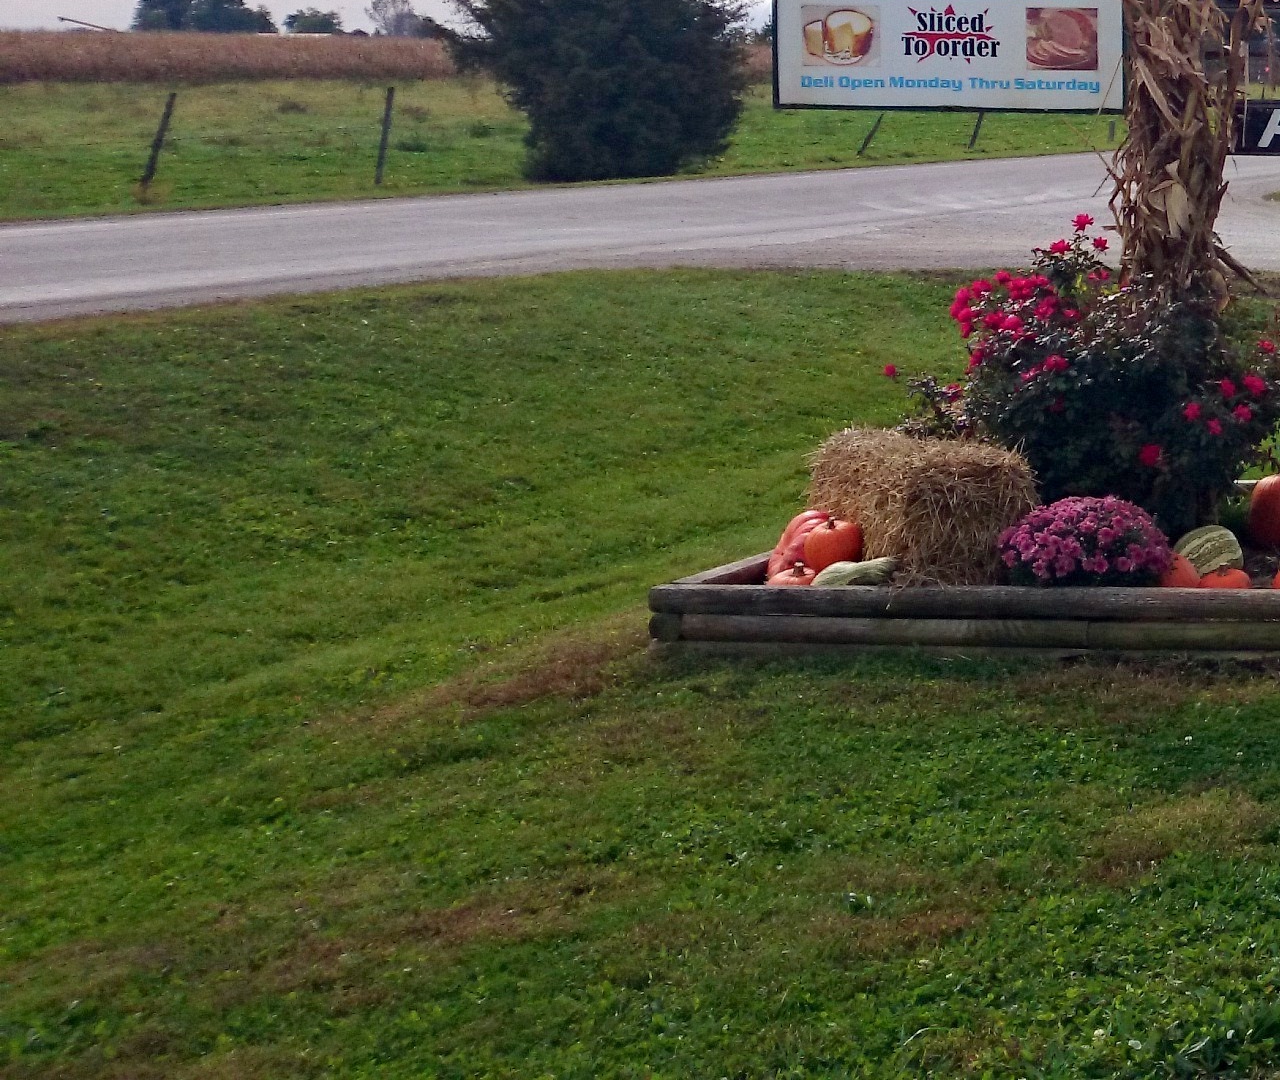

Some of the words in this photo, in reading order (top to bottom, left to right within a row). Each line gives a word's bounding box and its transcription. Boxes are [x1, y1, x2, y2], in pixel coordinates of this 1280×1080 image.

[916, 12, 984, 33] Sliced
[901, 36, 927, 58] To
[936, 37, 1000, 58] order
[801, 76, 834, 88] Deli
[838, 77, 885, 91] Open
[889, 77, 962, 91] Monday
[968, 77, 1010, 90] Thru
[1014, 78, 1100, 93] Saturday
